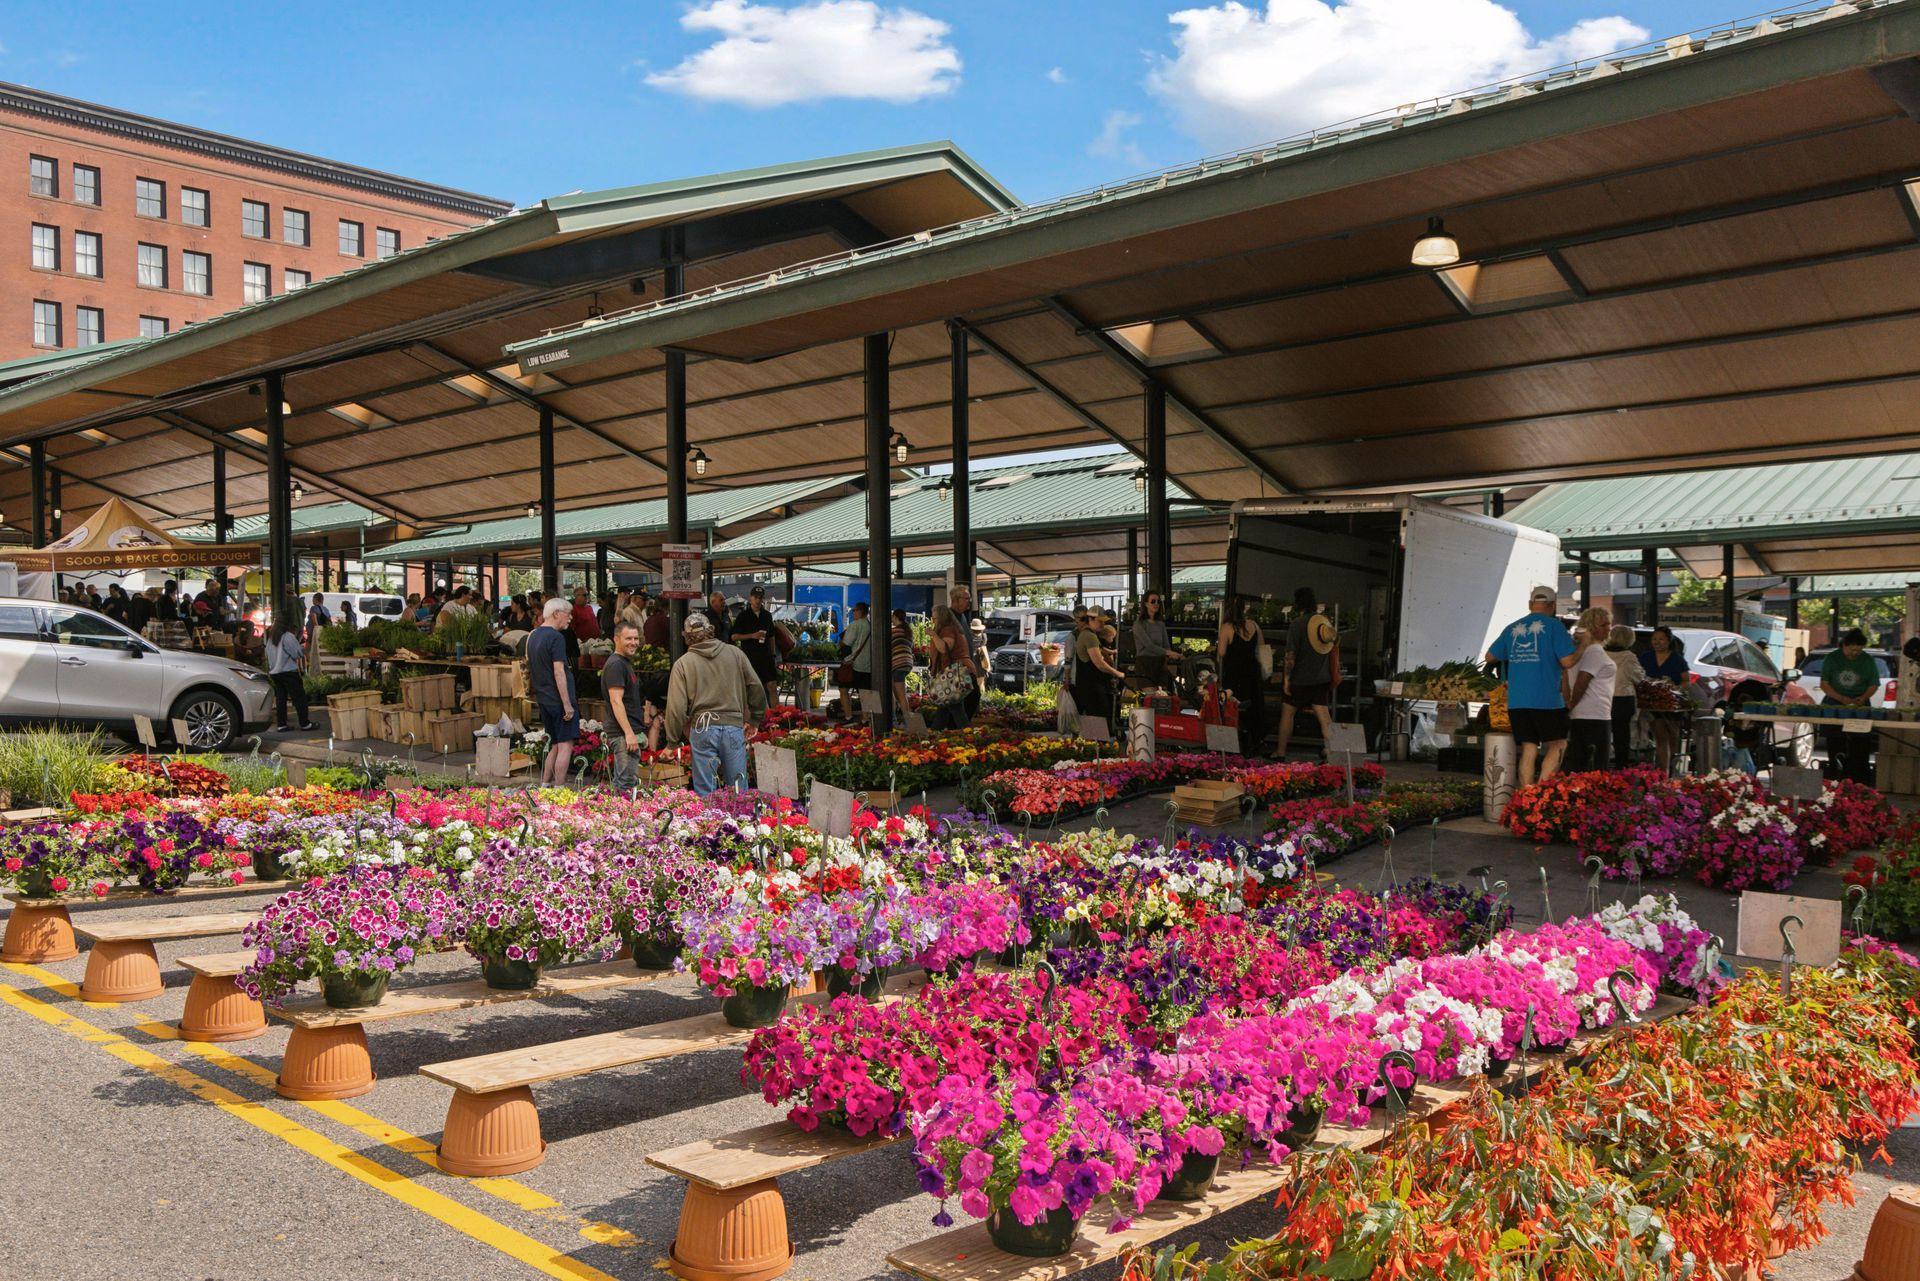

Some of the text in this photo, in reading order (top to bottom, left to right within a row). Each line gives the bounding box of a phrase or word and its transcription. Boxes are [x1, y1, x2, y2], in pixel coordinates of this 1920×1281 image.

[527, 349, 570, 367] LOW CLEARANCE
[65, 552, 251, 566] SCOOP & BAKE COOKIE DOUGH
